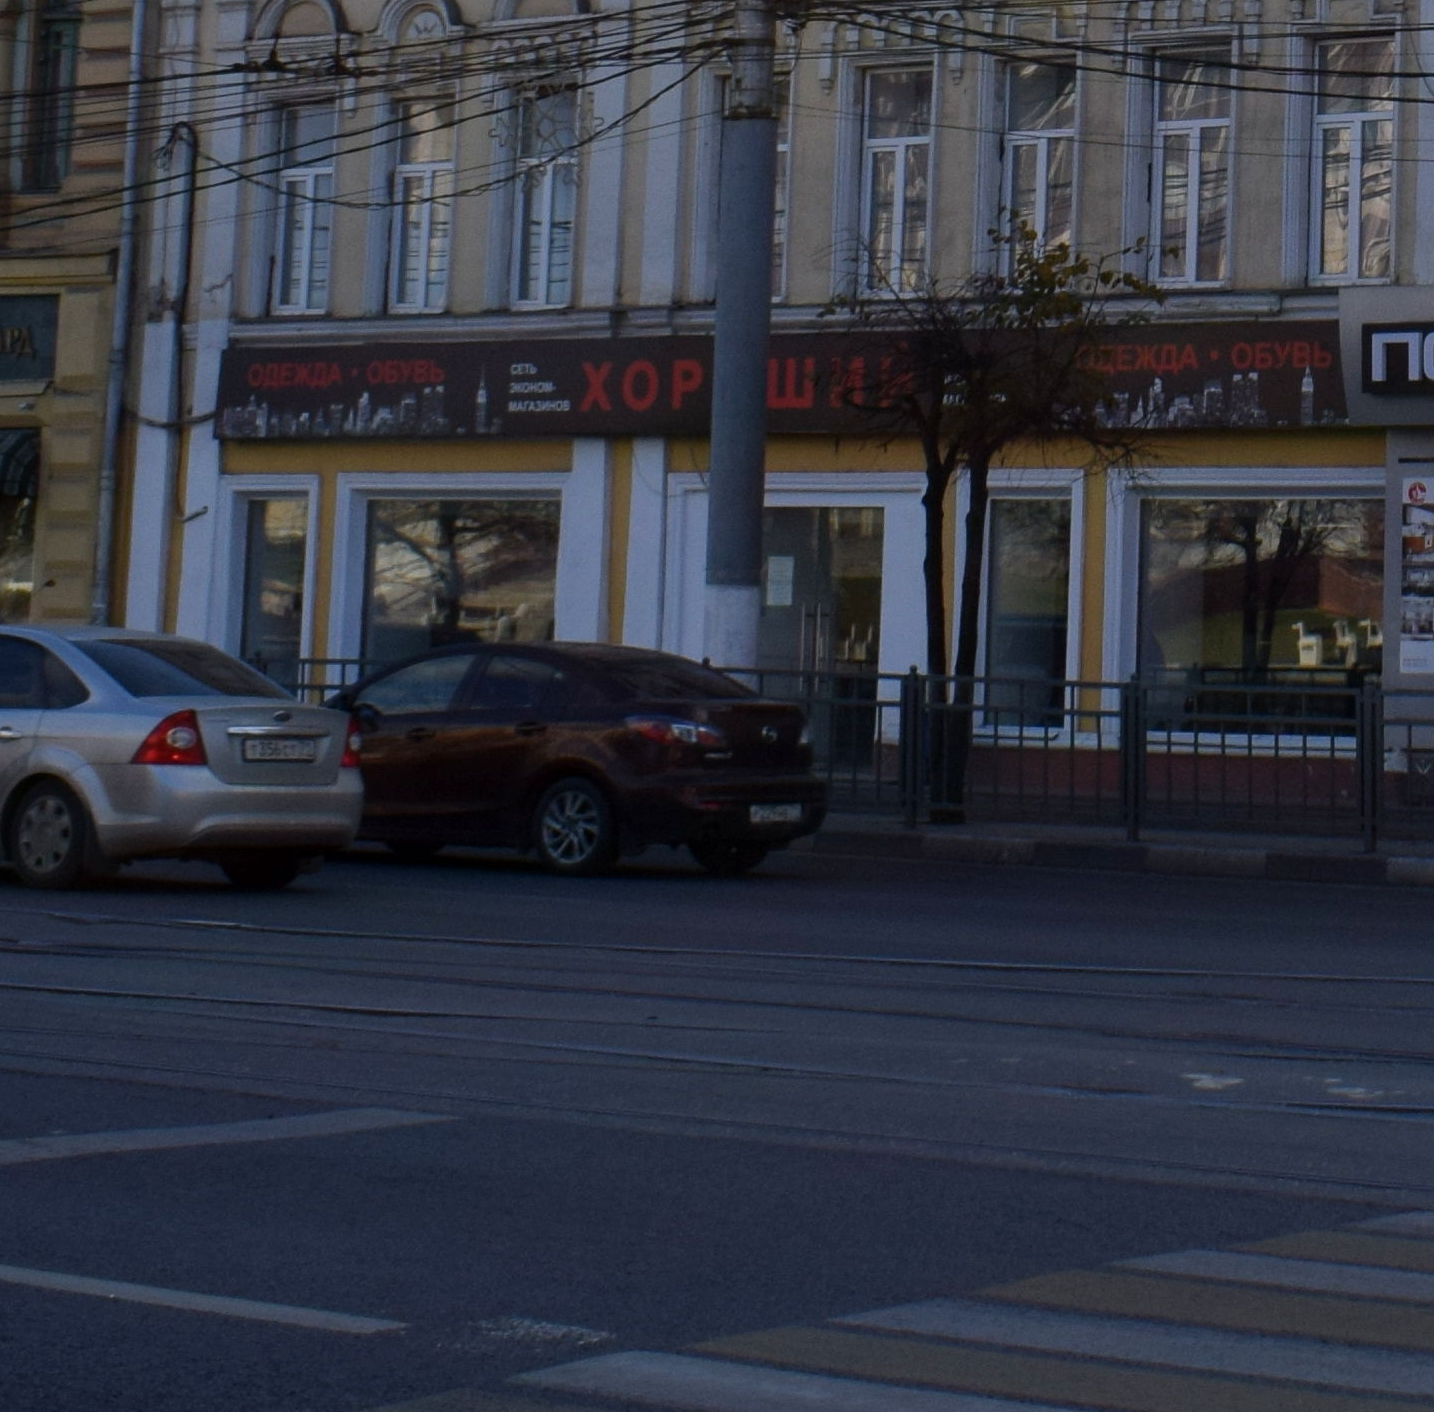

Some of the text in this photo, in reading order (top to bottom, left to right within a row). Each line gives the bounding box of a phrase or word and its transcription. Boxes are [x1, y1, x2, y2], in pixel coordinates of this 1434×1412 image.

[509, 363, 538, 376] СЕТЬ
[1230, 341, 1334, 370] ОБУВЬ
[246, 358, 447, 392] ОДЕЖДА ОБУВЬ
[580, 343, 916, 413] ХОРШИЙ
[508, 399, 572, 413] МАГАЗИНОВ
